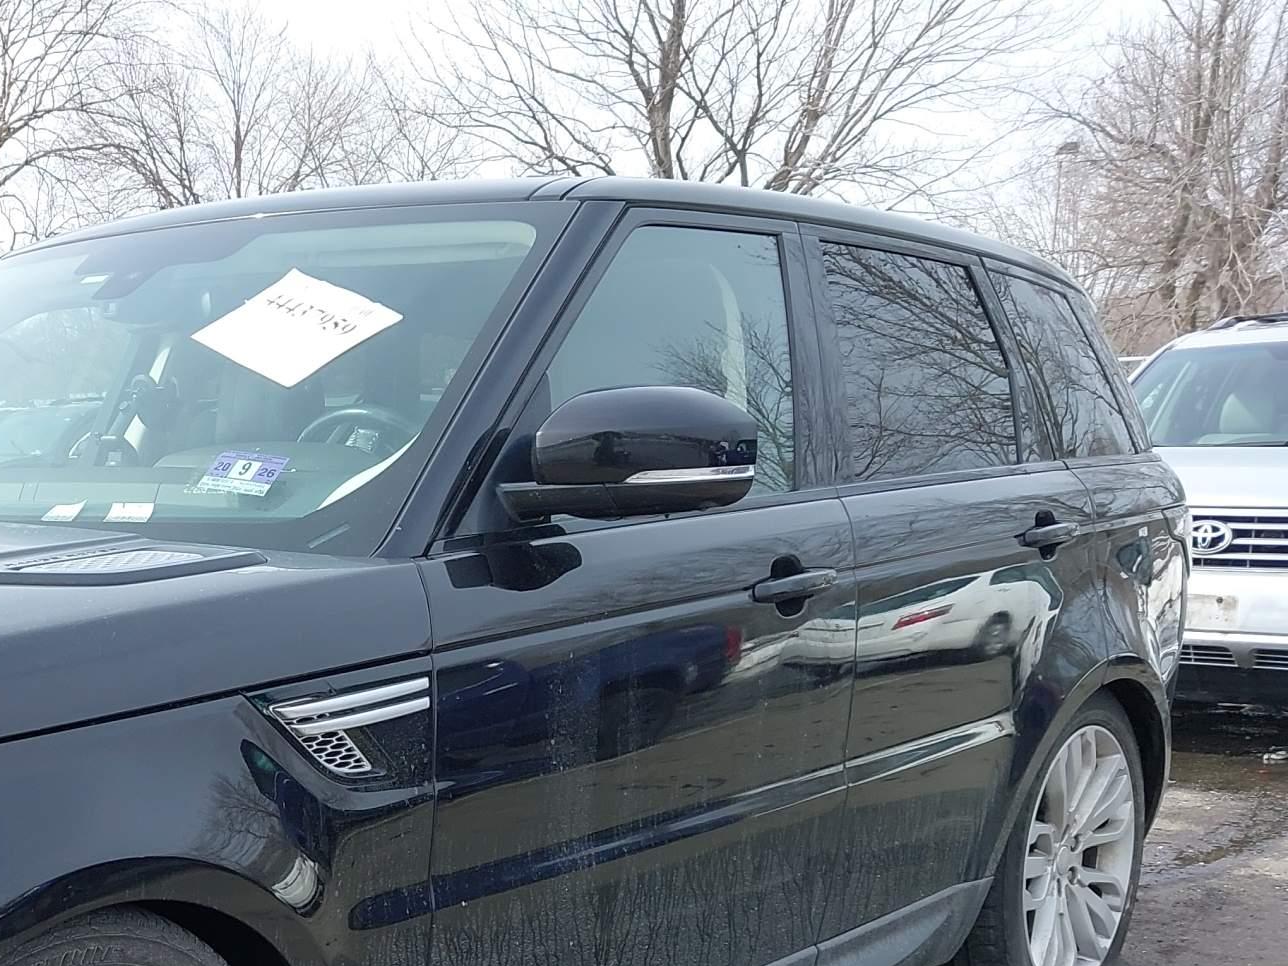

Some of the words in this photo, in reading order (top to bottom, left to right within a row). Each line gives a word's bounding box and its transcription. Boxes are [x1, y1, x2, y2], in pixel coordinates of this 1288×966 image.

[214, 461, 232, 472] 20
[238, 461, 253, 476] 9
[257, 467, 277, 478] 26
